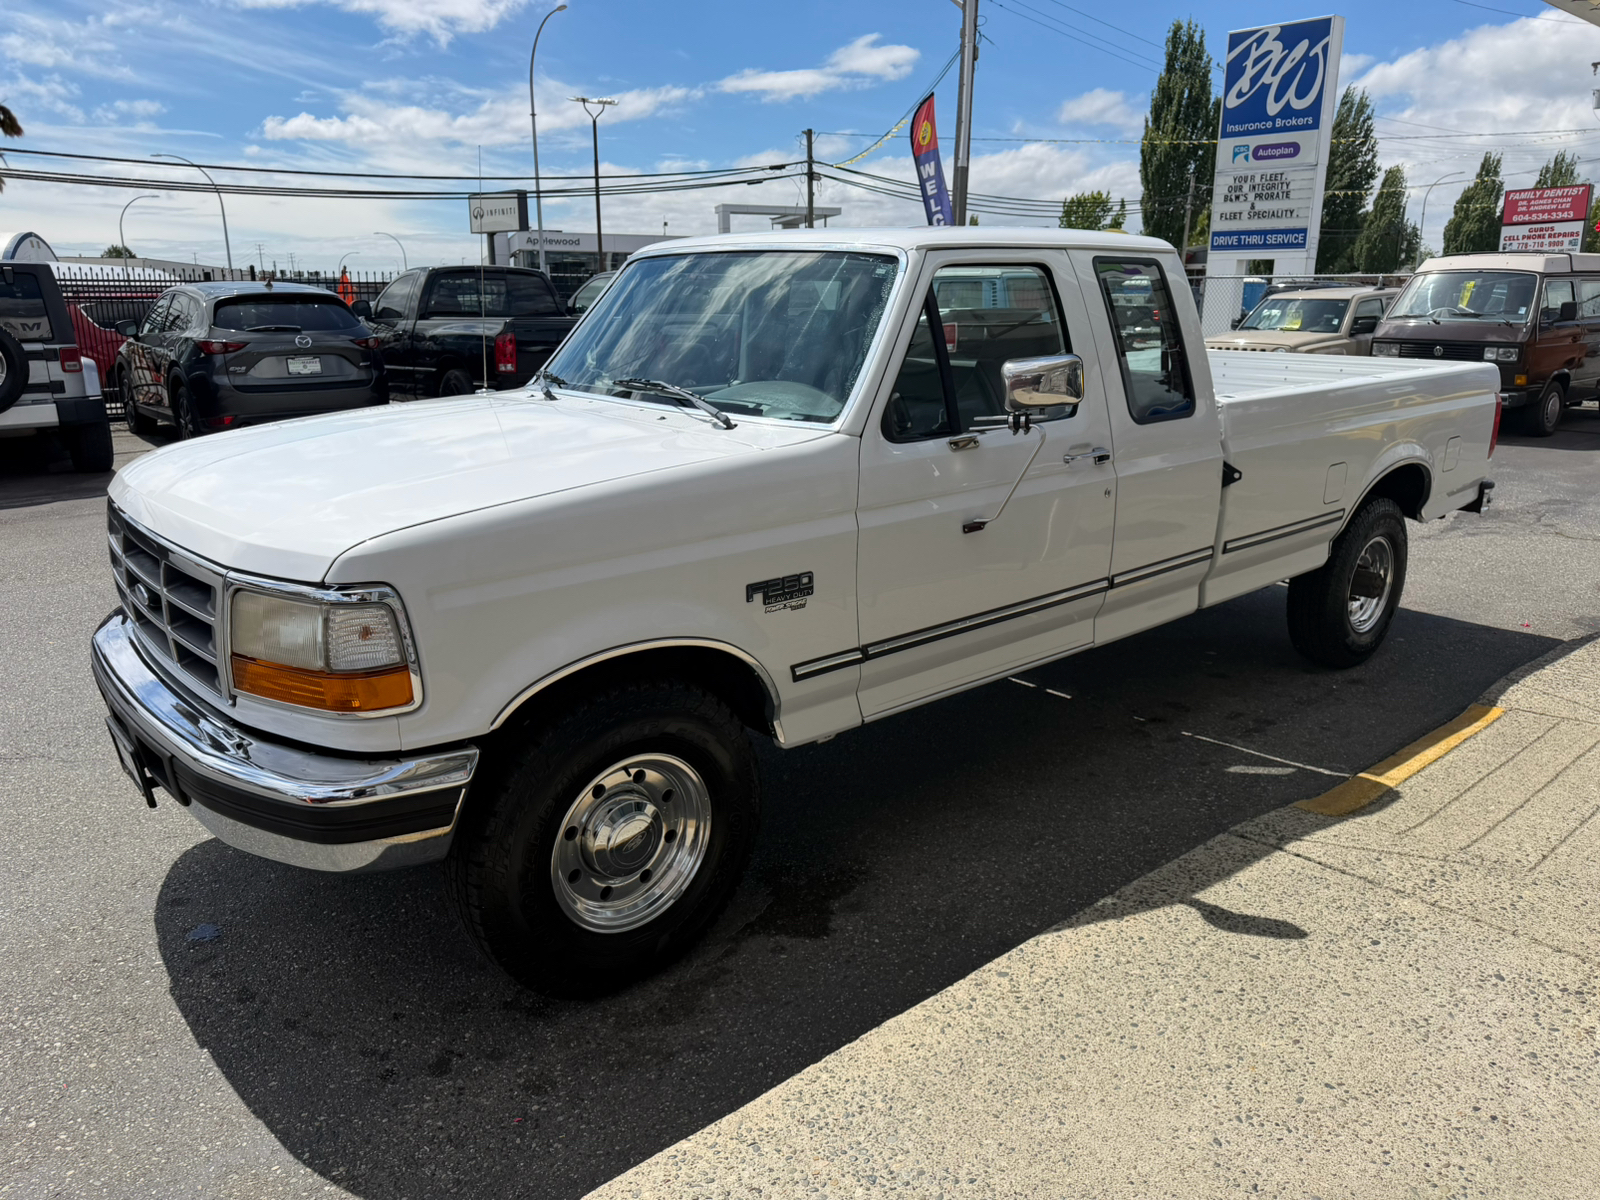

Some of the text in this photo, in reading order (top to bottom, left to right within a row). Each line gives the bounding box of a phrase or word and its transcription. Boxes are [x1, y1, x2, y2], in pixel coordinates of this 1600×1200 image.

[1226, 116, 1313, 133] Insurance Brokers
[1257, 146, 1294, 157] Autoplan
[1233, 172, 1287, 184] YOUR FLEET.
[1227, 181, 1291, 193] OUR INTEGRITY
[1224, 190, 1291, 203] B&W'S PRORATE
[1509, 187, 1586, 200] FAMILY DENTIST
[486, 207, 516, 217] INFINITI
[1220, 209, 1299, 221] FLEET SPECIALITY.
[1512, 211, 1574, 222] 604-534-3343
[1213, 233, 1305, 246] DRIVE THRU SERVICE
[1522, 233, 1546, 241] PHONE
[1547, 231, 1580, 239] REPAIRS
[765, 588, 813, 605] HEAVY DUTY
